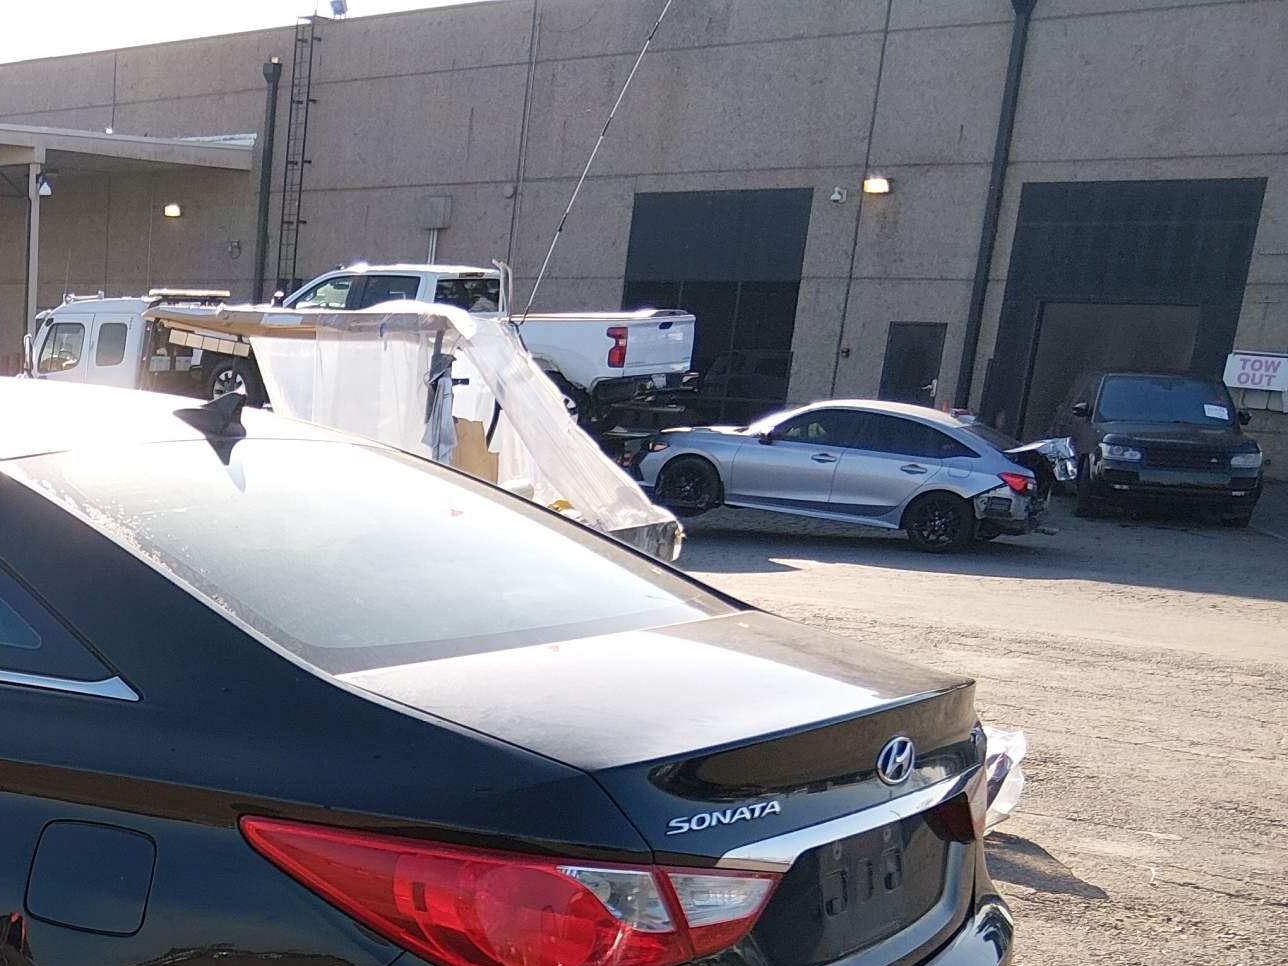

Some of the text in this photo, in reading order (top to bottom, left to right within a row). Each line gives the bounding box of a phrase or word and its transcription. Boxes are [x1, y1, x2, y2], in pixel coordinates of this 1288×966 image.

[1239, 357, 1281, 373] TOW
[1237, 372, 1276, 387] OUT
[666, 800, 782, 836] SONATA
